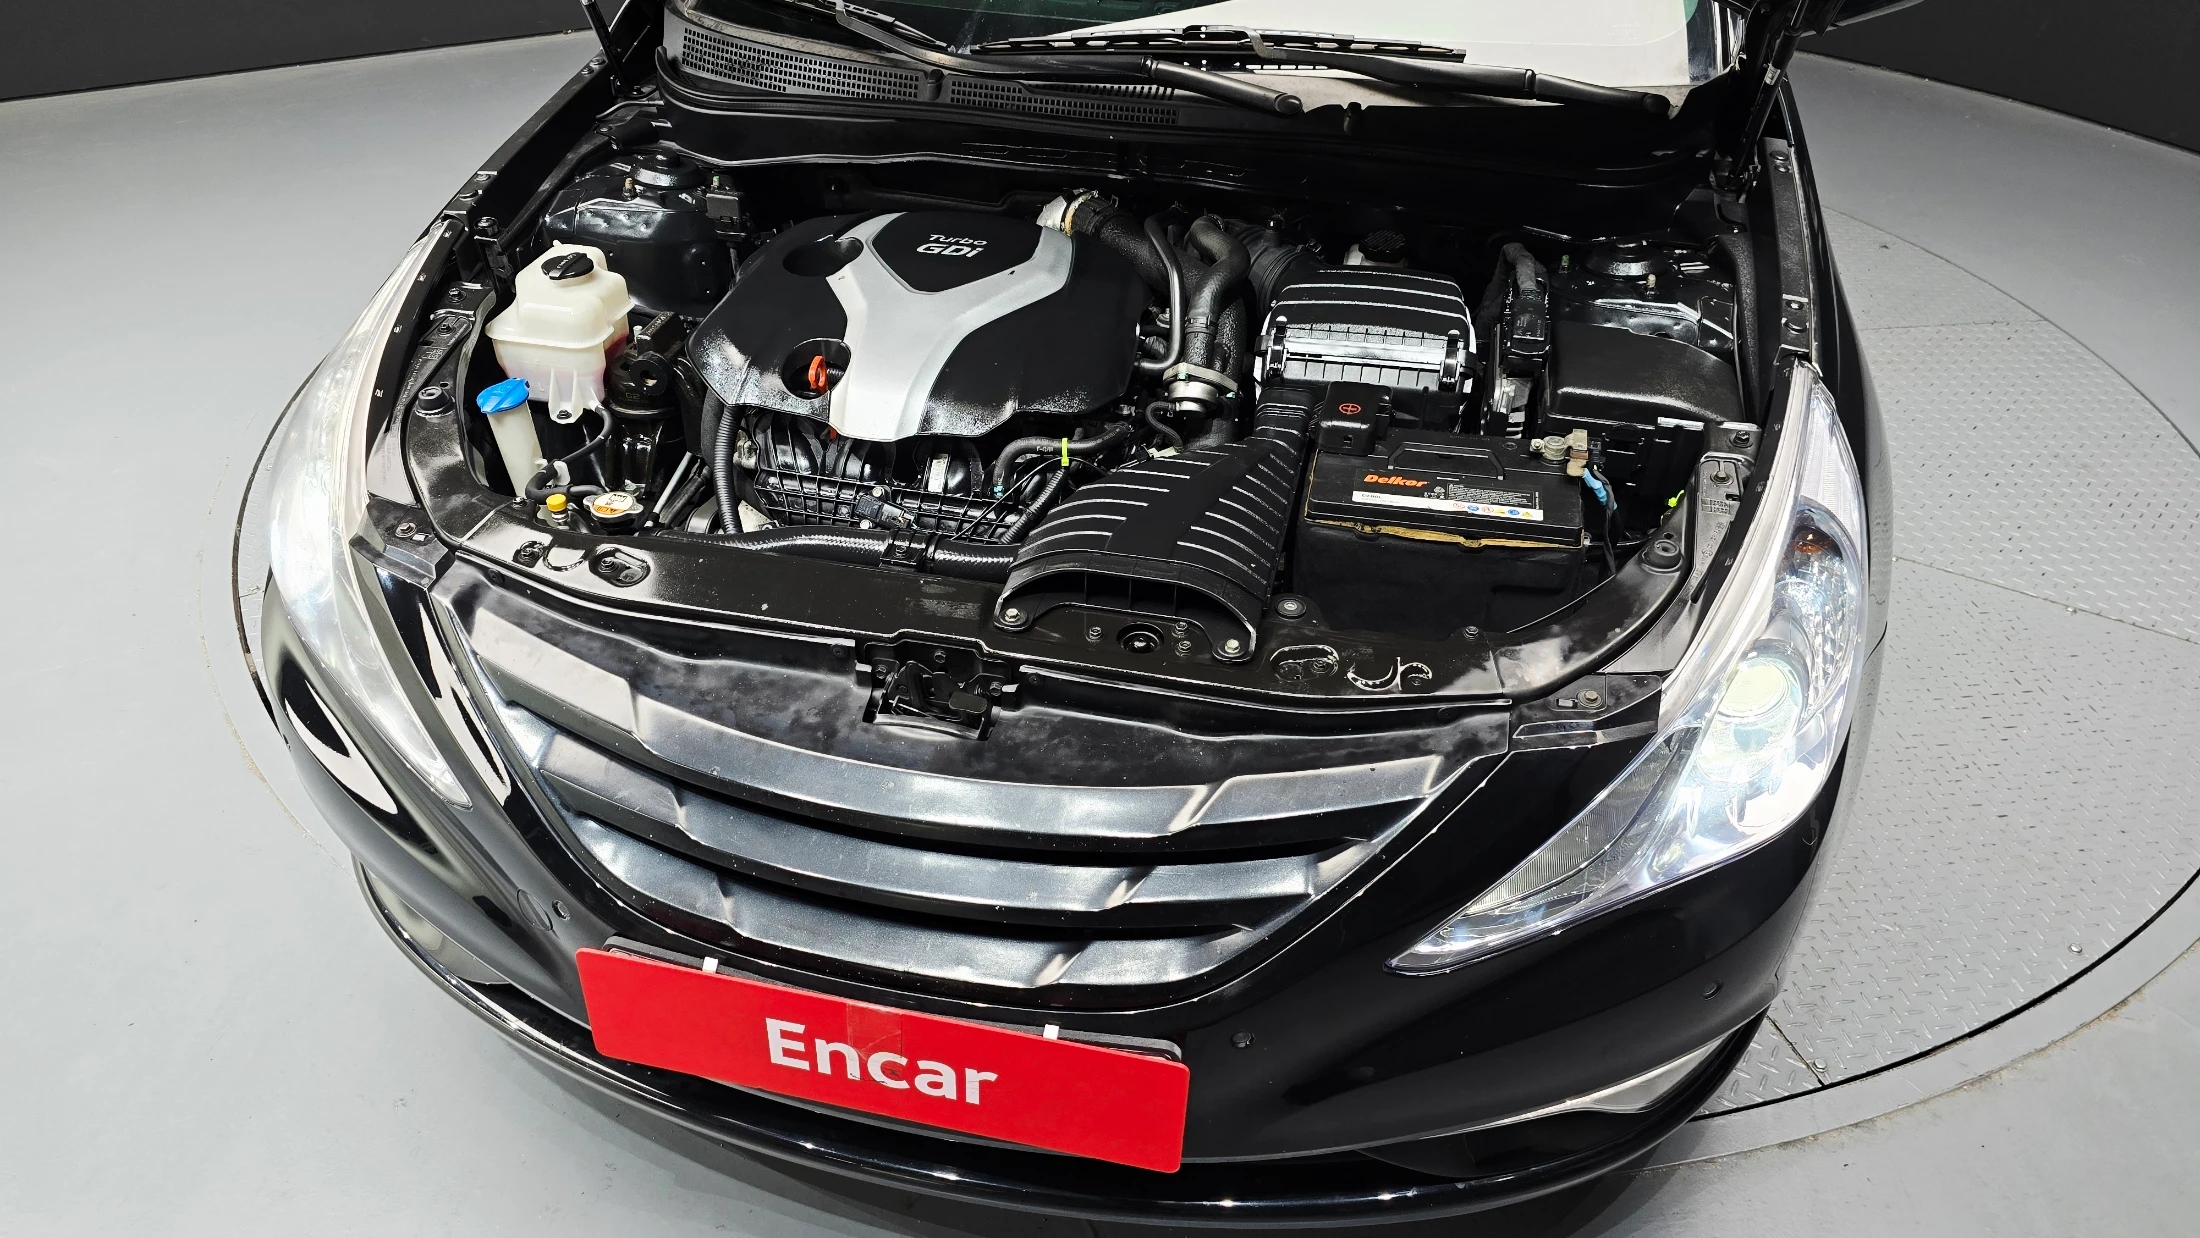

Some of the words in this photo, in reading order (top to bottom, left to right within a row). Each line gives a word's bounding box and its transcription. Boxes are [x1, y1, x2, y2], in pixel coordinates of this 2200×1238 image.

[929, 234, 987, 245] Turbo
[1363, 474, 1428, 488] Delkor
[765, 1017, 999, 1105] Encar
